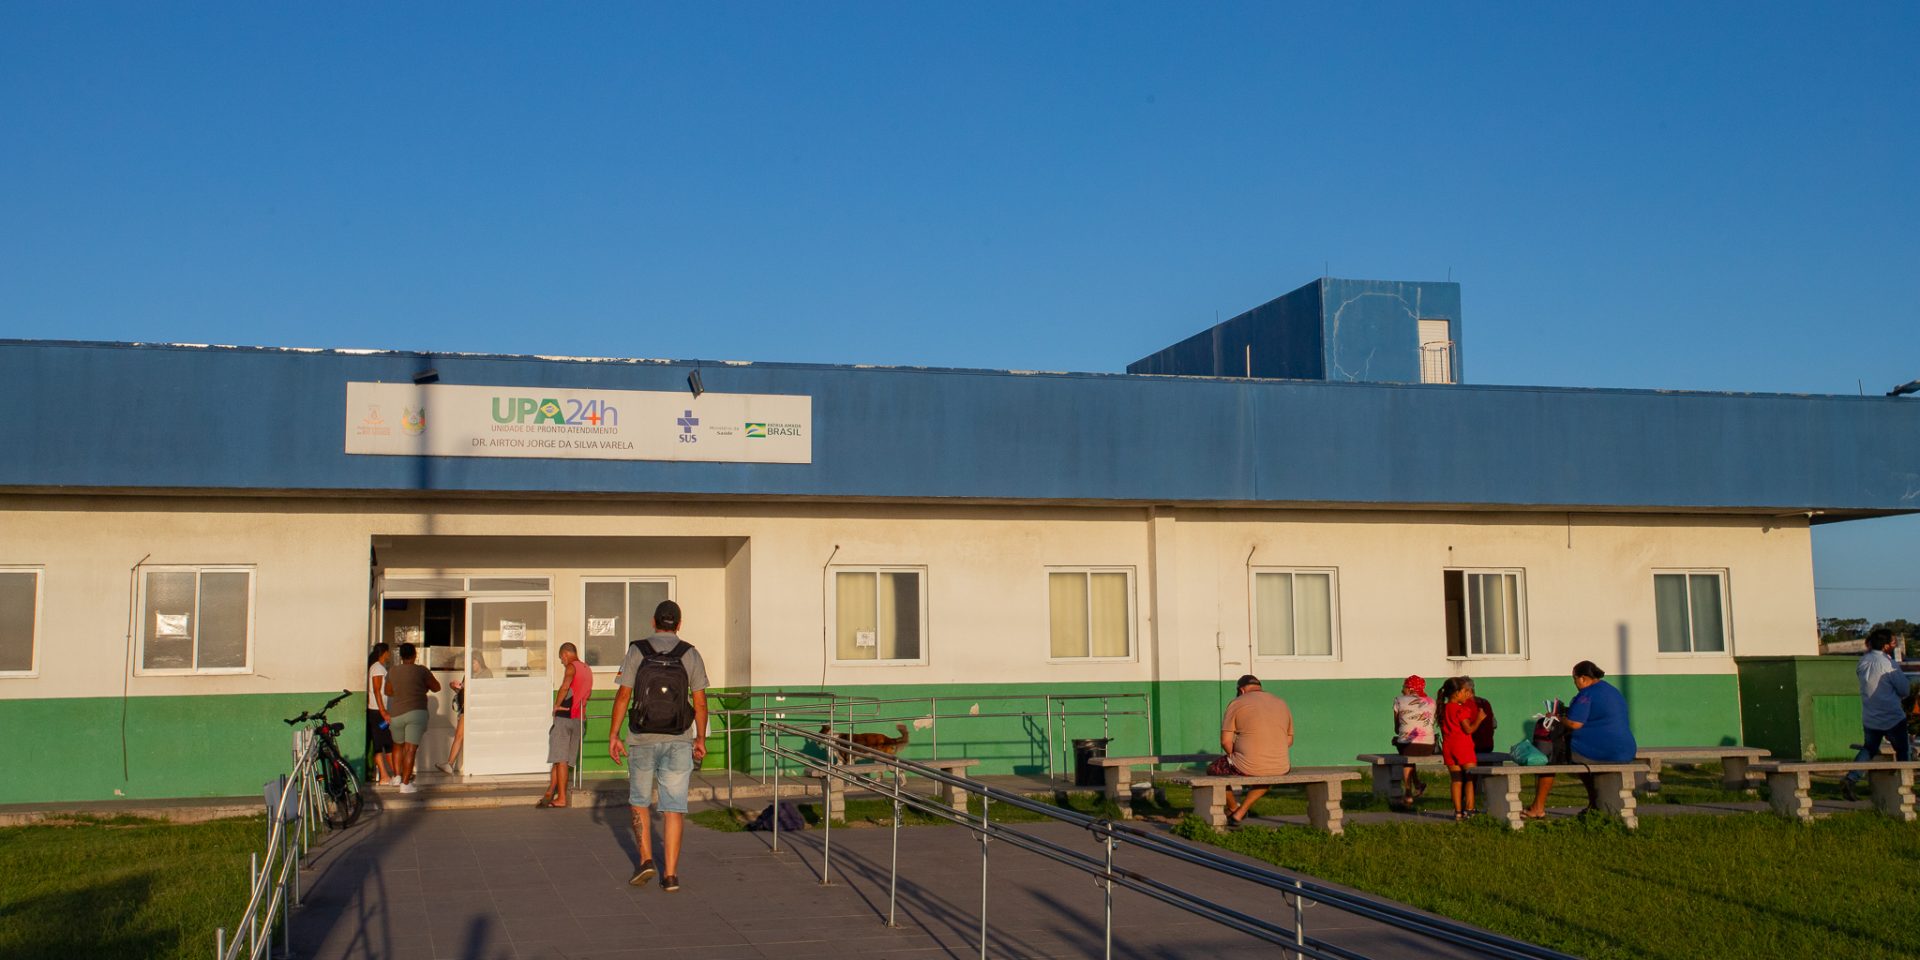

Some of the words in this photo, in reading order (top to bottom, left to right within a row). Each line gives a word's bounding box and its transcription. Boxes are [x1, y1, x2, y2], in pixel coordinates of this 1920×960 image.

[491, 425, 524, 433] UNIDADE
[525, 425, 535, 433] DE
[537, 426, 567, 434] PRONTO
[567, 426, 619, 435] ATENDIMENTO
[768, 428, 802, 436] BRASIL
[679, 434, 697, 443] SUS
[471, 438, 488, 447] DR.
[489, 438, 525, 448] AIRTON
[526, 439, 556, 449] JORGE
[558, 440, 572, 449] DA
[574, 440, 598, 449] SILVA
[599, 441, 634, 450] VARELA
